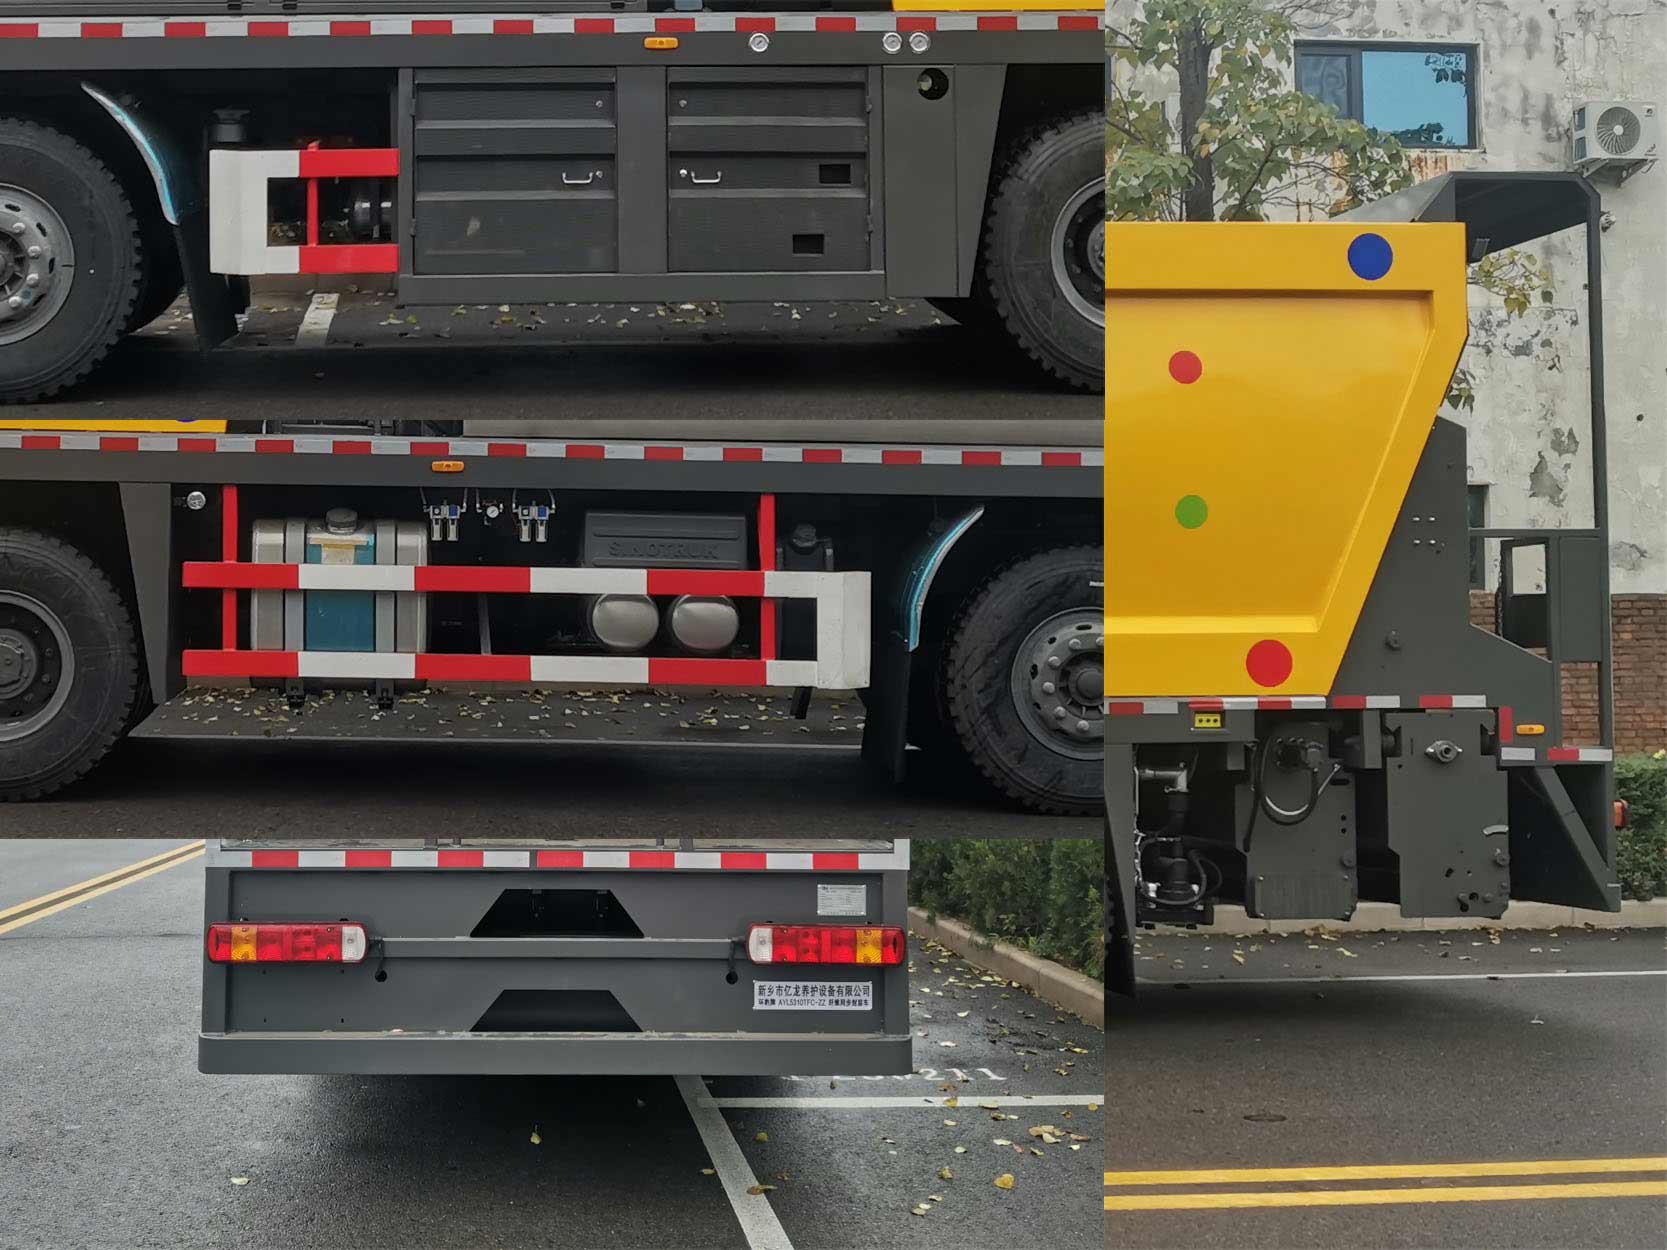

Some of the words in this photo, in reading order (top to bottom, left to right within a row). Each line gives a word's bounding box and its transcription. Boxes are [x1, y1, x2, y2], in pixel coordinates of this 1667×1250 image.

[608, 541, 720, 560] SINOTRUK
[758, 984, 871, 998] 新乡市亿龙养护设备有限公司
